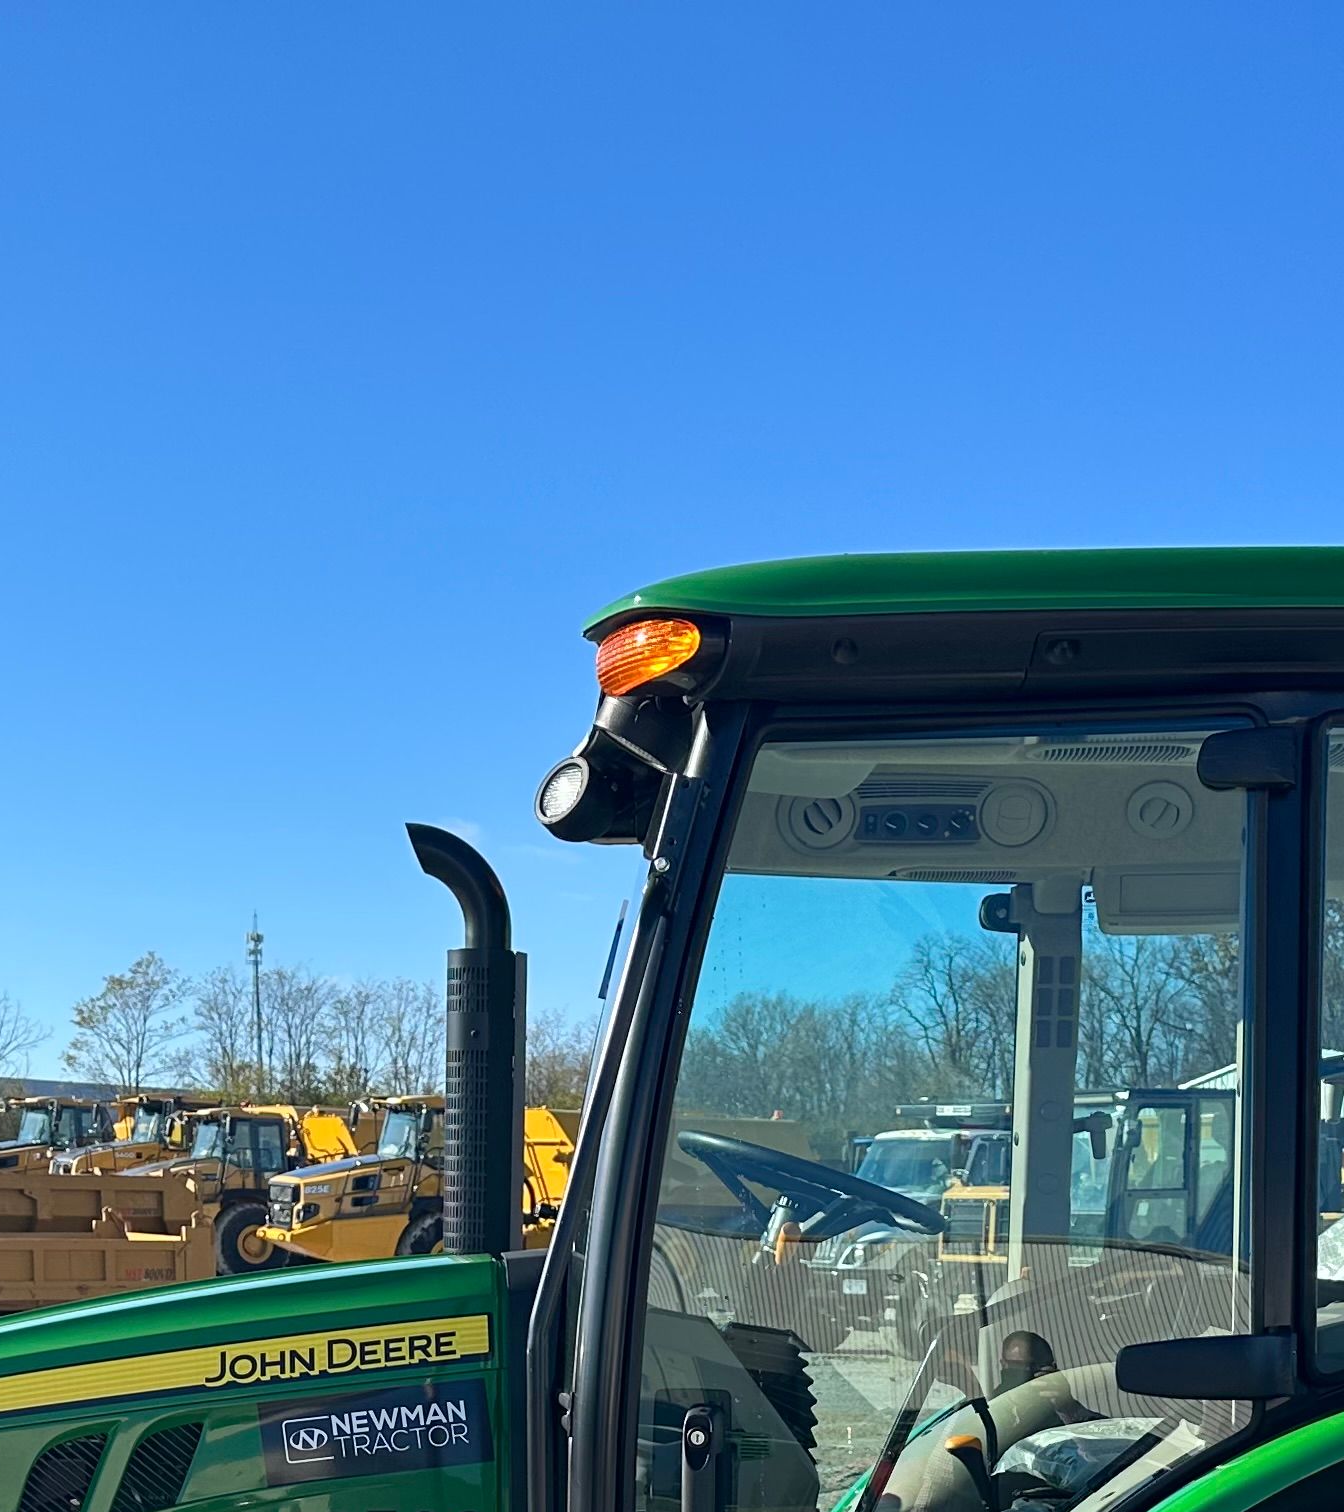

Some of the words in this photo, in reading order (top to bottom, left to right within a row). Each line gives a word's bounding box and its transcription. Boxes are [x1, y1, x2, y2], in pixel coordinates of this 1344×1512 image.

[207, 1347, 315, 1384] JOHN
[327, 1331, 457, 1369] DEERE
[330, 1400, 467, 1436] NEWMAN
[334, 1424, 470, 1458] TRACTOR
